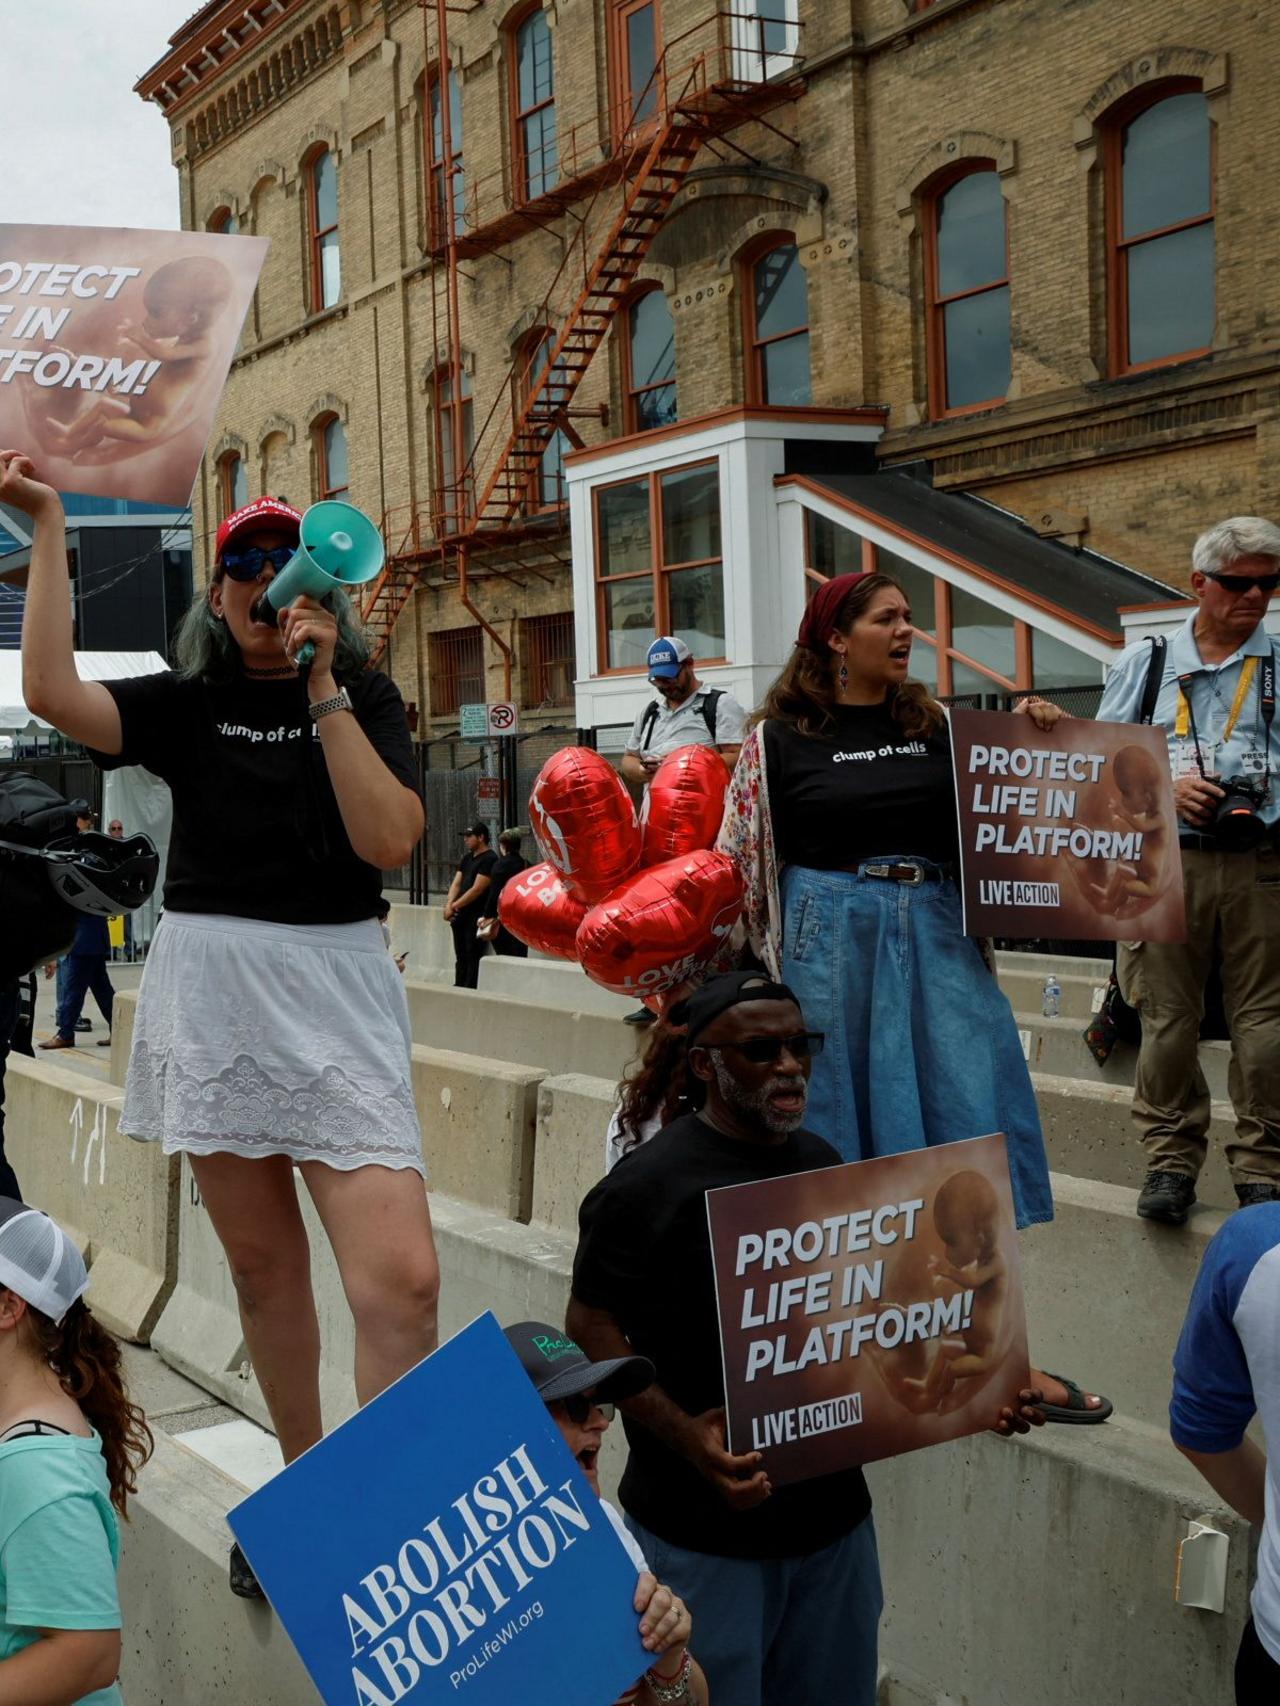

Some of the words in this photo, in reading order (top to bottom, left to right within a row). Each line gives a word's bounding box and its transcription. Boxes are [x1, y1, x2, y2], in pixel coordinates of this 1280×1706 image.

[12, 306, 70, 340] IN
[227, 504, 258, 526] MAKE
[260, 500, 303, 521] AMERIC
[1264, 666, 1273, 697] SONY
[266, 726, 285, 742] of
[832, 750, 877, 763] clump
[895, 741, 926, 754] cells
[969, 744, 1106, 783] PROTECT
[1241, 752, 1269, 760] PRESS
[972, 784, 1039, 816] LIFE
[1045, 788, 1076, 819] IN
[975, 823, 1144, 861] PLATFORM!
[515, 865, 552, 898] LO
[979, 880, 1012, 905] LIVE
[1014, 882, 1059, 905] ACTION
[735, 1199, 924, 1276] PROTECT
[741, 1271, 833, 1329] LIFE
[841, 1260, 885, 1306] IN
[745, 1290, 974, 1382] PLATFORM!
[752, 1408, 797, 1449] LIVE
[800, 1393, 862, 1436] ACTION
[342, 1443, 549, 1658] ABOLISH
[351, 1479, 591, 1706] ABORTION
[449, 1601, 544, 1689] ProLifeWI.org
